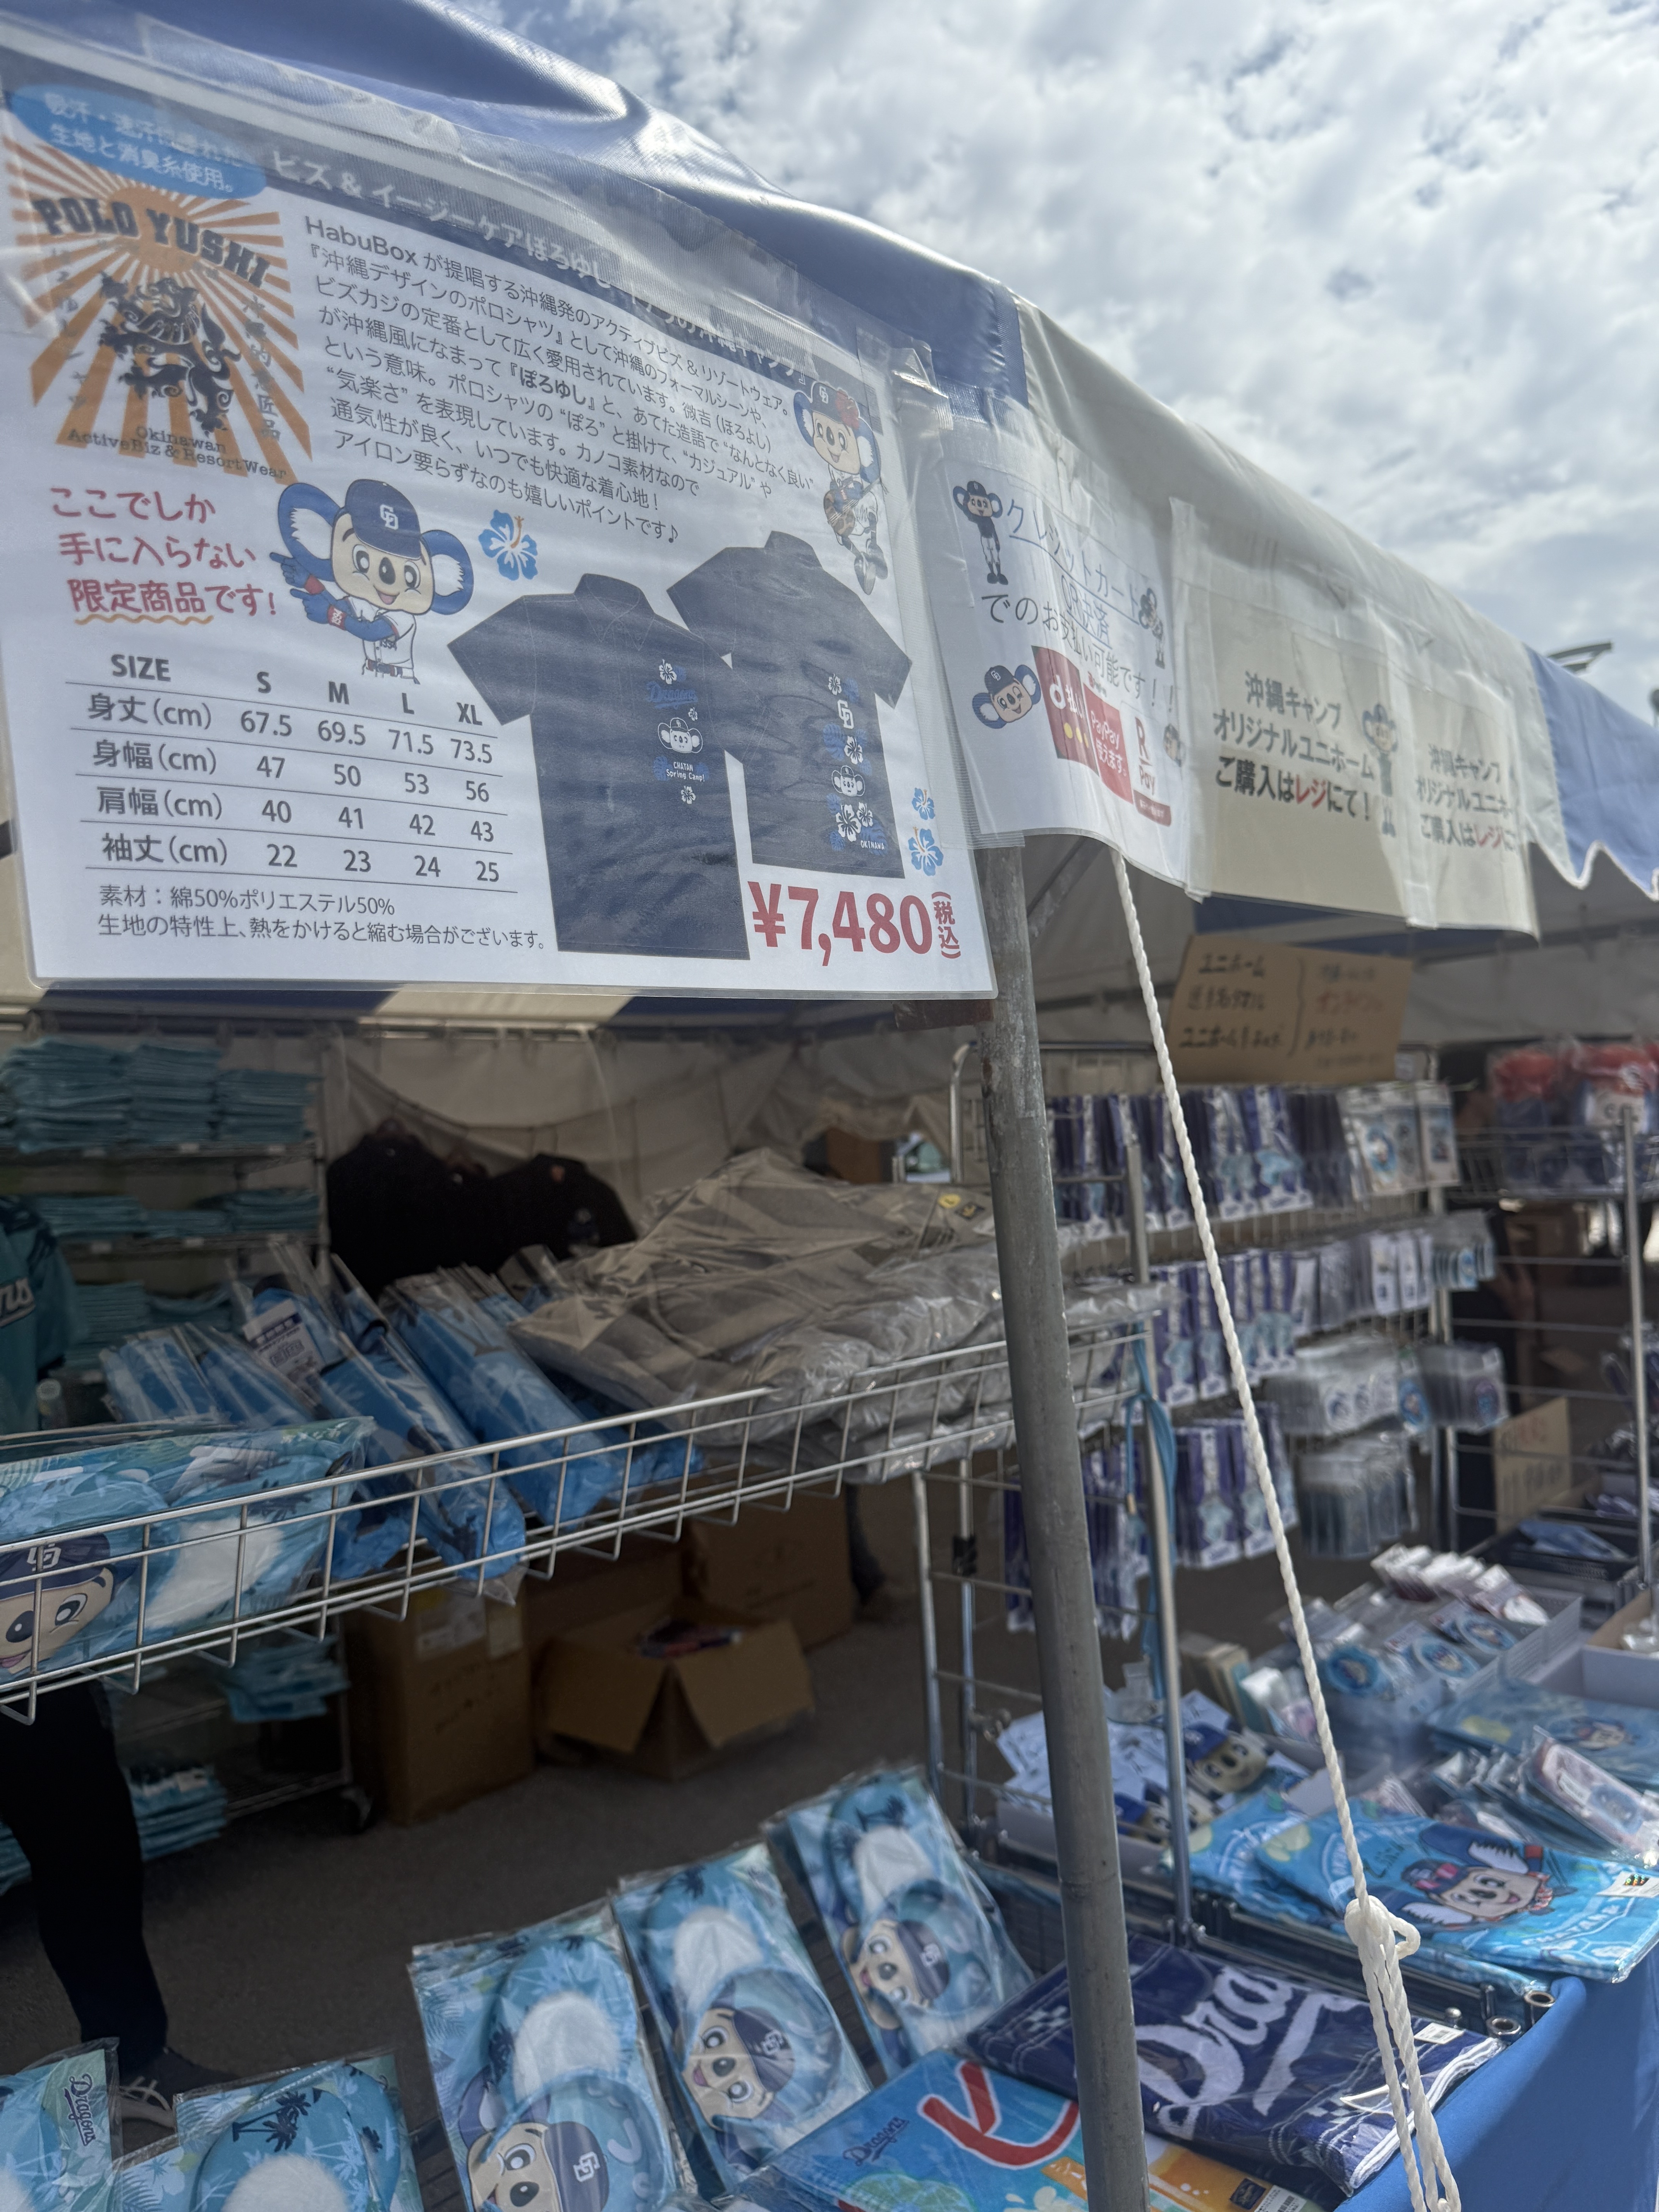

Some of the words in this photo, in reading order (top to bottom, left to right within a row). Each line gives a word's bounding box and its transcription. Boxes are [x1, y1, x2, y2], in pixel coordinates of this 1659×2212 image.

[31, 197, 140, 239] POLO
[145, 208, 270, 289] YUSHI
[305, 216, 419, 266] HabuBox
[136, 425, 227, 455] Okinawan
[165, 442, 180, 458] &
[50, 487, 216, 524] ここでしか
[58, 532, 256, 569] 手に入らない
[66, 579, 277, 617] 限定商品です！
[110, 654, 172, 682] SIZE
[256, 671, 272, 694] S
[328, 681, 350, 706] M
[402, 692, 415, 715] L
[456, 701, 483, 726] XL
[1245, 671, 1341, 731] 沖縄キャンプ
[240, 710, 293, 737] 67.5
[318, 720, 366, 746] 69.5
[388, 729, 434, 755] 71.5
[450, 738, 493, 764] 73.5
[1090, 709, 1119, 750] PayPay
[1212, 709, 1375, 780] オリジナルユニホーム
[256, 755, 286, 779] 47
[334, 764, 362, 787] 50
[404, 772, 430, 795] 53
[465, 780, 490, 803] 56
[1215, 755, 1371, 821] ご購入はレジにて！
[261, 799, 293, 824] 40
[338, 807, 364, 830] 41
[409, 814, 436, 836] 42
[470, 820, 494, 842] 43
[266, 843, 298, 868] 22
[343, 849, 372, 873] 23
[414, 855, 441, 878] 24
[475, 860, 500, 883] 25
[98, 914, 544, 950] 生地の特性上、熱をかけると縮む場合がございます。
[747, 881, 933, 967] ¥7,480
[64, 2073, 97, 2147] Dragons
[842, 2116, 910, 2167] Dragons
